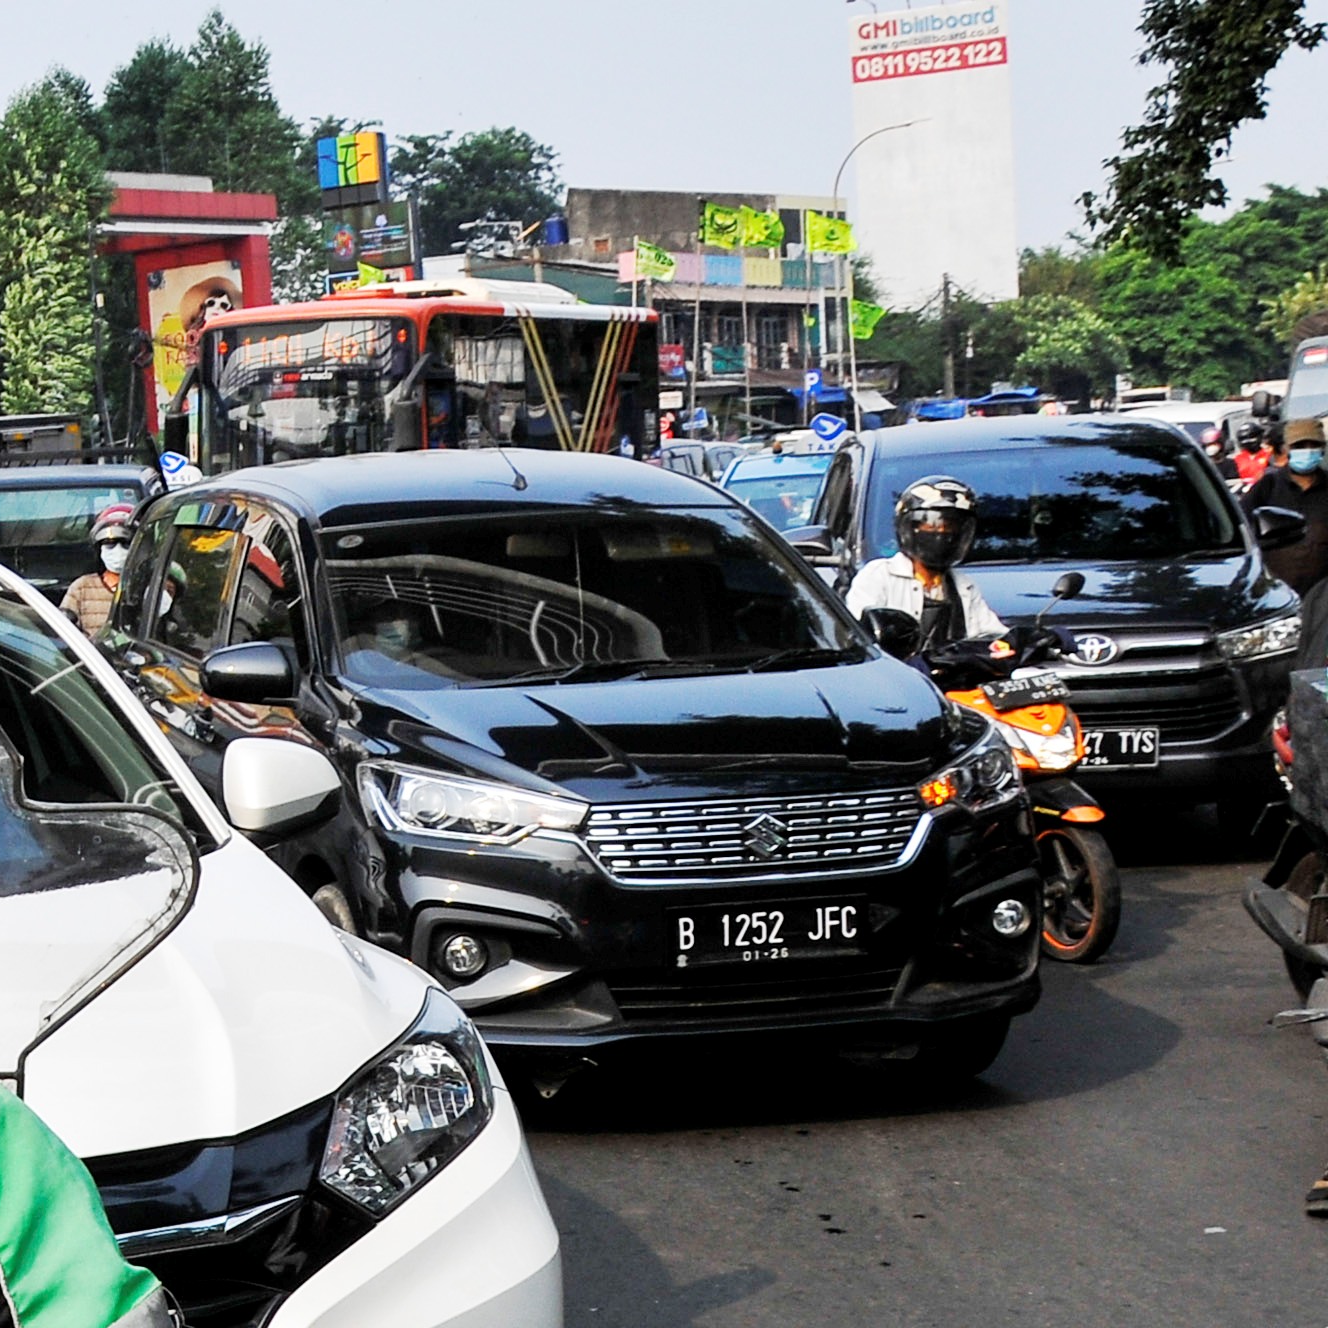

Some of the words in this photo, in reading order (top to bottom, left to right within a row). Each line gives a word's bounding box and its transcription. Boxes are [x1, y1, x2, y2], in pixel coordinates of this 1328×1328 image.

[1118, 731, 1155, 754] TYS
[678, 917, 694, 950] B
[722, 911, 784, 947] 1252
[808, 906, 857, 940] JFC
